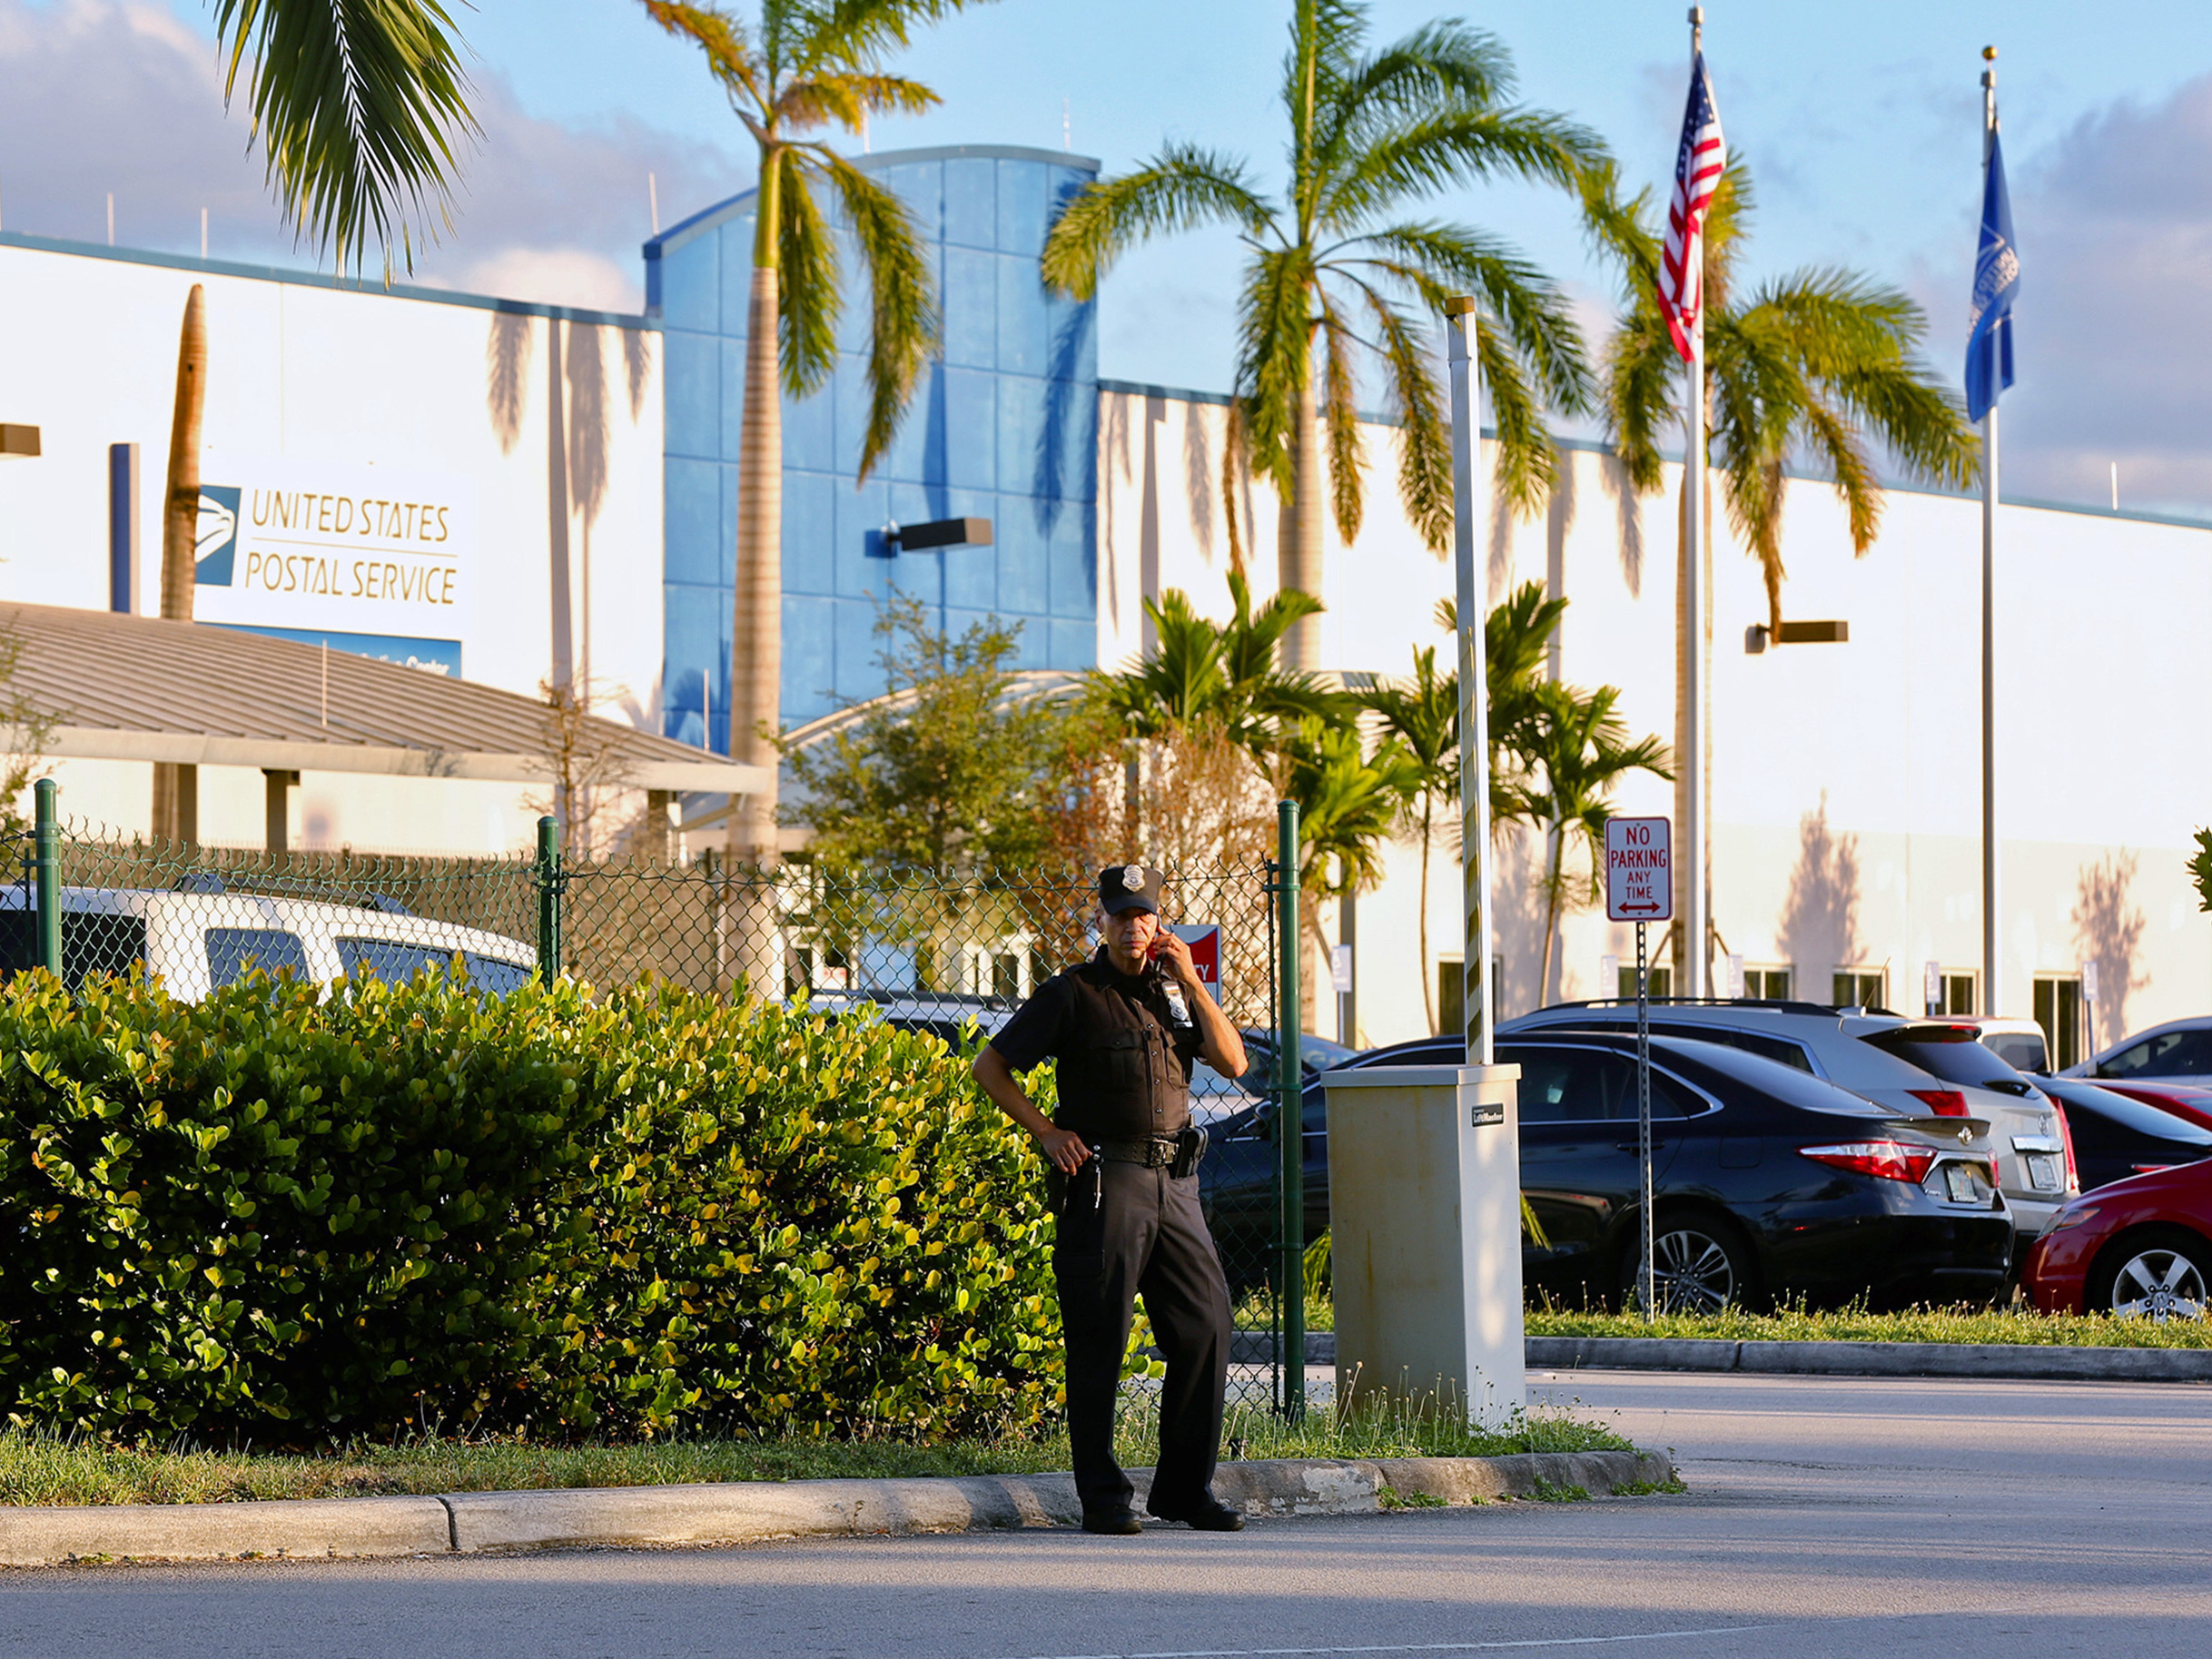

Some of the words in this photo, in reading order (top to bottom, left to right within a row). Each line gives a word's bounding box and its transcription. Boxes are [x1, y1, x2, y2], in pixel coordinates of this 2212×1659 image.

[252, 489, 353, 534] UNITED
[359, 499, 449, 542] STATES
[245, 552, 343, 596] POSTAL
[351, 560, 457, 605] SERVICE
[1626, 826, 1650, 845] NO
[1610, 848, 1666, 868] PARKING
[1626, 871, 1651, 884] ANY
[1625, 885, 1653, 899] TIME
